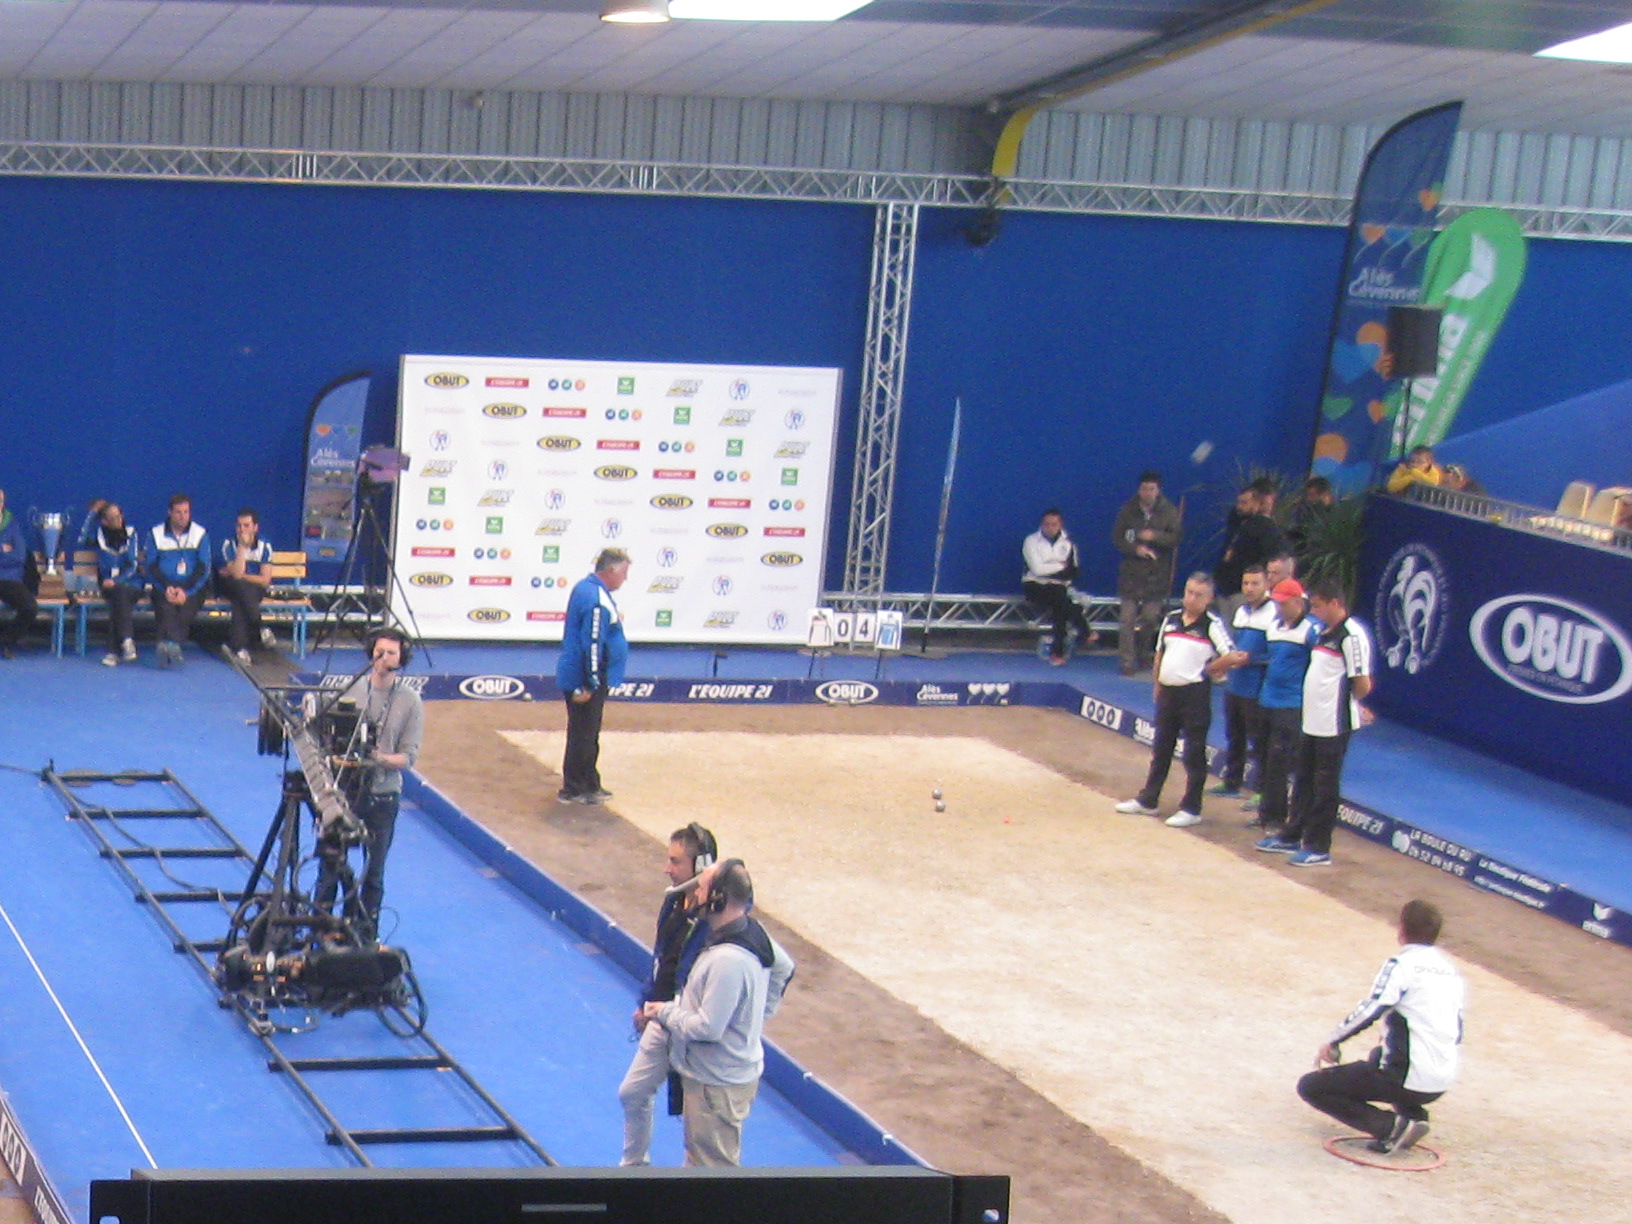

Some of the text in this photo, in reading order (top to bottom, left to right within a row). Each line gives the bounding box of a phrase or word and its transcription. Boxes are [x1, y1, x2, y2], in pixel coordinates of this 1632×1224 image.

[837, 618, 869, 639] 0 4
[1501, 606, 1605, 684] OBUT
[472, 679, 513, 695] OBUT
[754, 684, 774, 699] 21
[828, 684, 867, 698] OBUT
